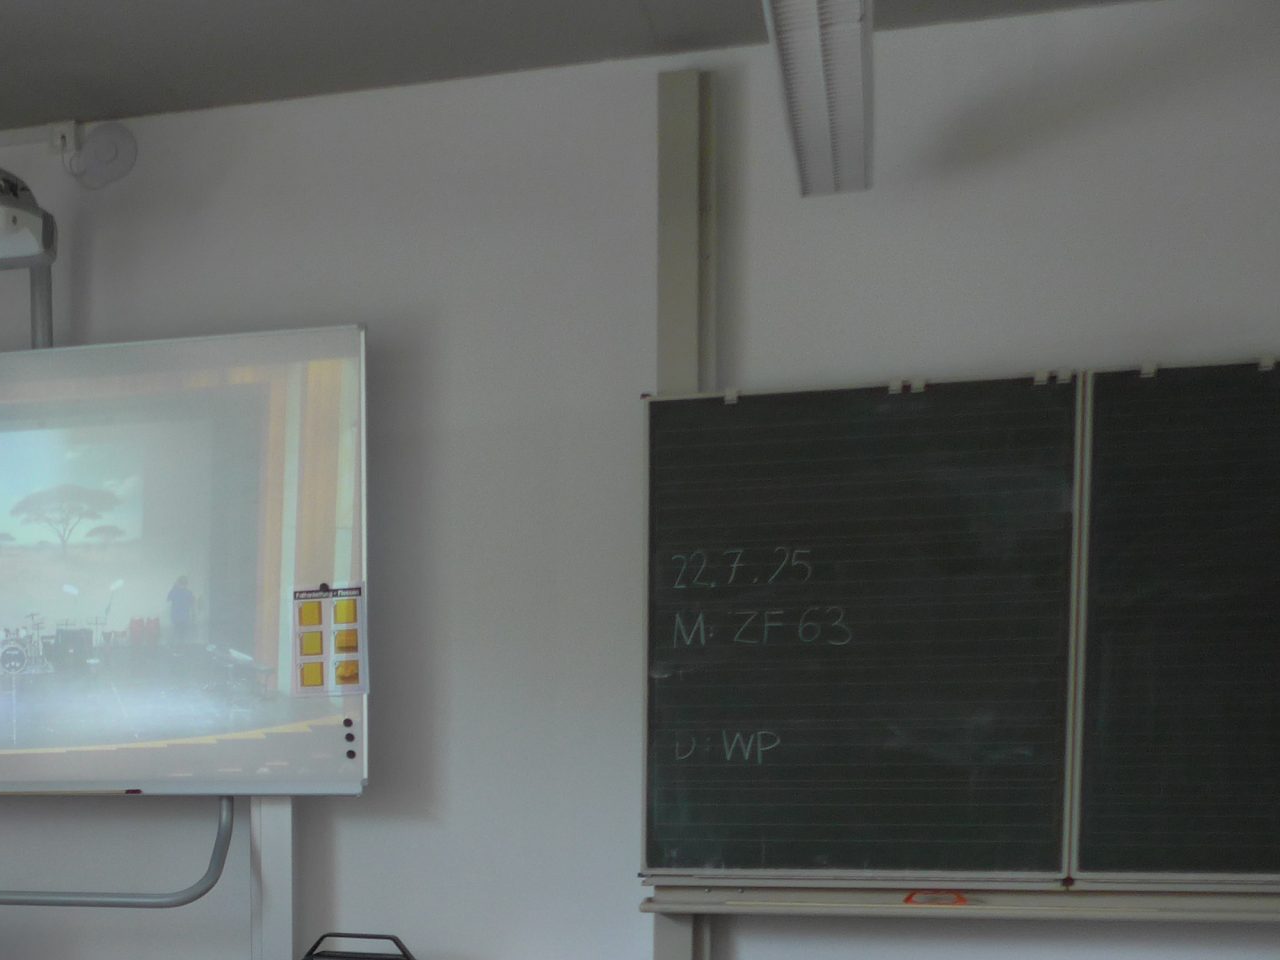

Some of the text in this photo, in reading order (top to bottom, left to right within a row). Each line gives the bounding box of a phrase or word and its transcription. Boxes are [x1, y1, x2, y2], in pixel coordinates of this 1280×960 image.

[727, 610, 785, 645] ZF
[798, 605, 853, 646] 63
[721, 729, 782, 765] WP
